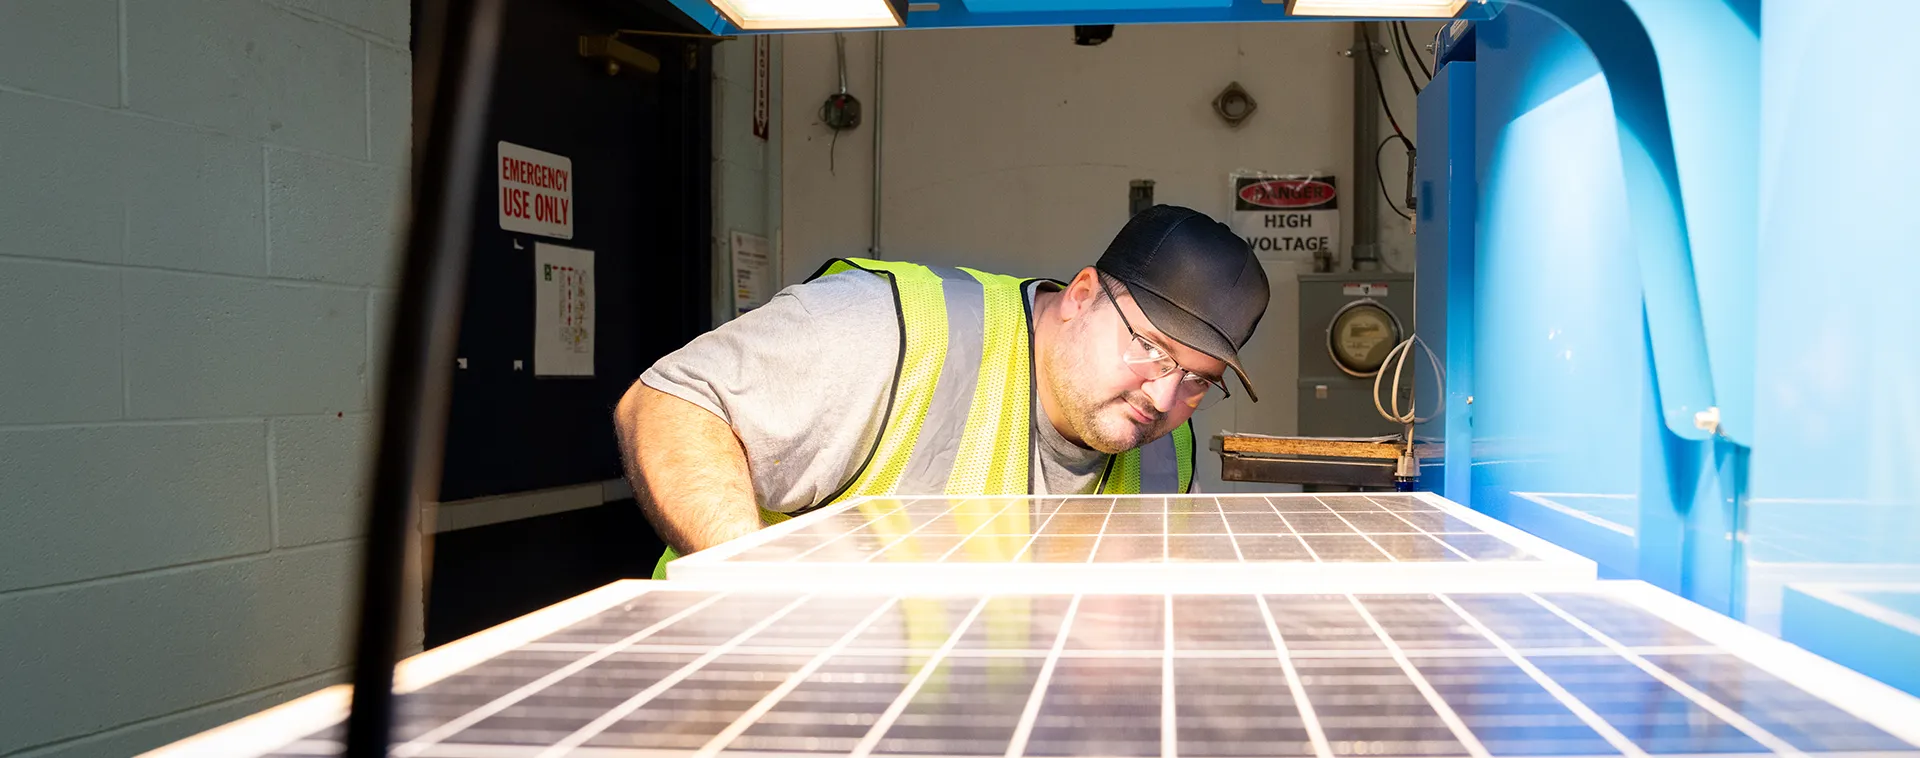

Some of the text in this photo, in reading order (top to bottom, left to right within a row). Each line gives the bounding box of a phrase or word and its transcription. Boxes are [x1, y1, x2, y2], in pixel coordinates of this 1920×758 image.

[758, 34, 766, 128] INGUISHER
[502, 156, 568, 193] EMERGENCY
[503, 186, 569, 226] USE ONLY
[1255, 185, 1324, 201] DANGER
[1264, 213, 1312, 229] HIGH
[1247, 236, 1329, 251] VOLTAGE
